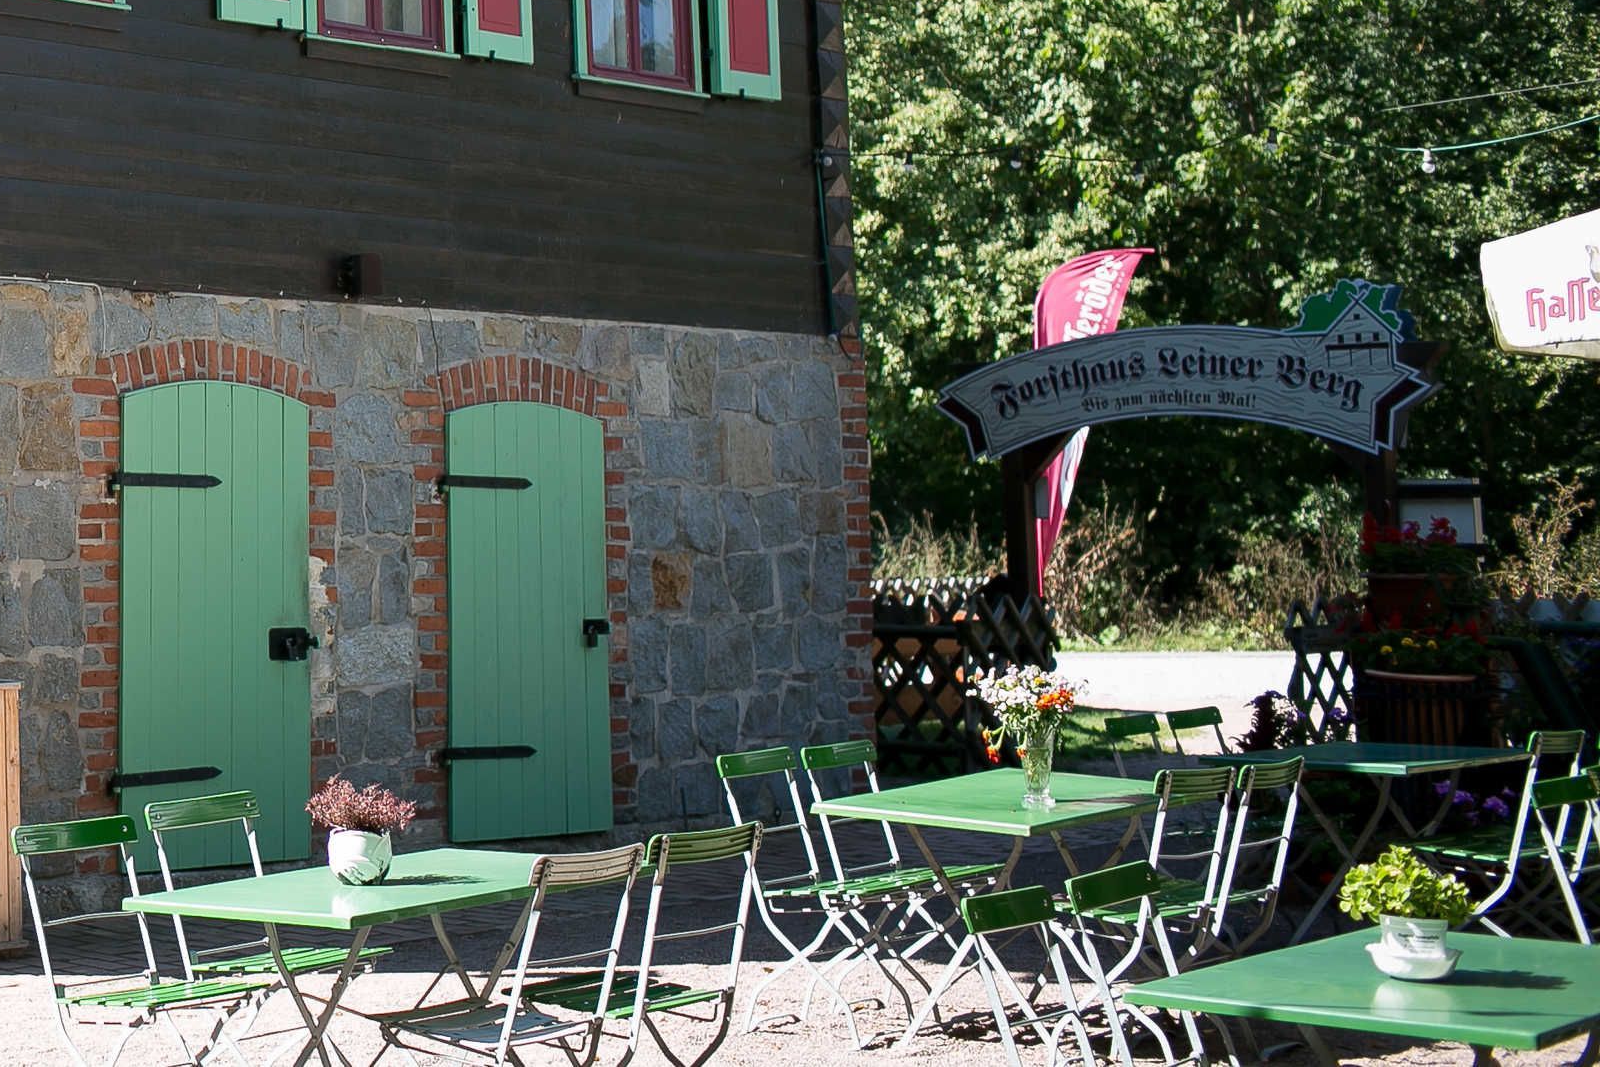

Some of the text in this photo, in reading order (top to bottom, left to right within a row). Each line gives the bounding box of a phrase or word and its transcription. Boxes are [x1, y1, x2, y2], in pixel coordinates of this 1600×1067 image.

[991, 346, 1365, 420] Forsthaus Leiner Berg
[1081, 388, 1256, 412] Bis zum nächsten Mal!
